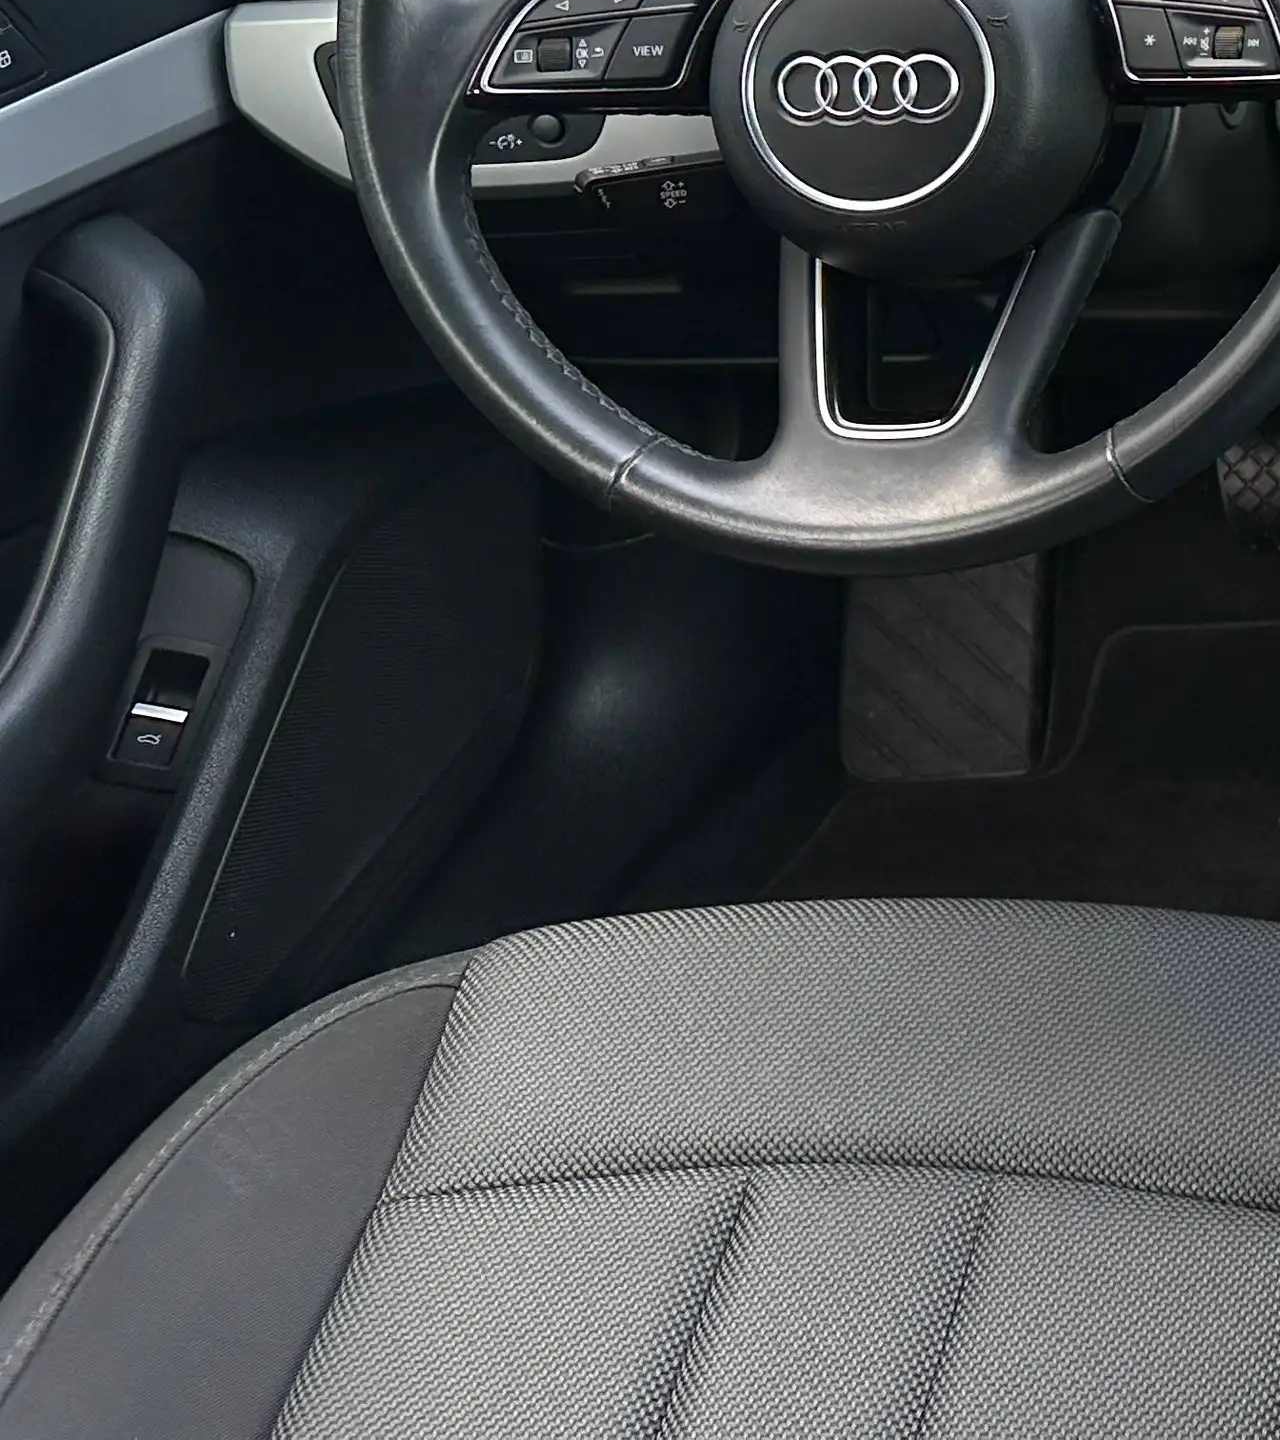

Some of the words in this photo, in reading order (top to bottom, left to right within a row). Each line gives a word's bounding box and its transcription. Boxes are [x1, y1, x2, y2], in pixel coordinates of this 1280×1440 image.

[575, 47, 589, 59] OK
[632, 44, 665, 57] VIEW
[659, 188, 688, 200] SPEED
